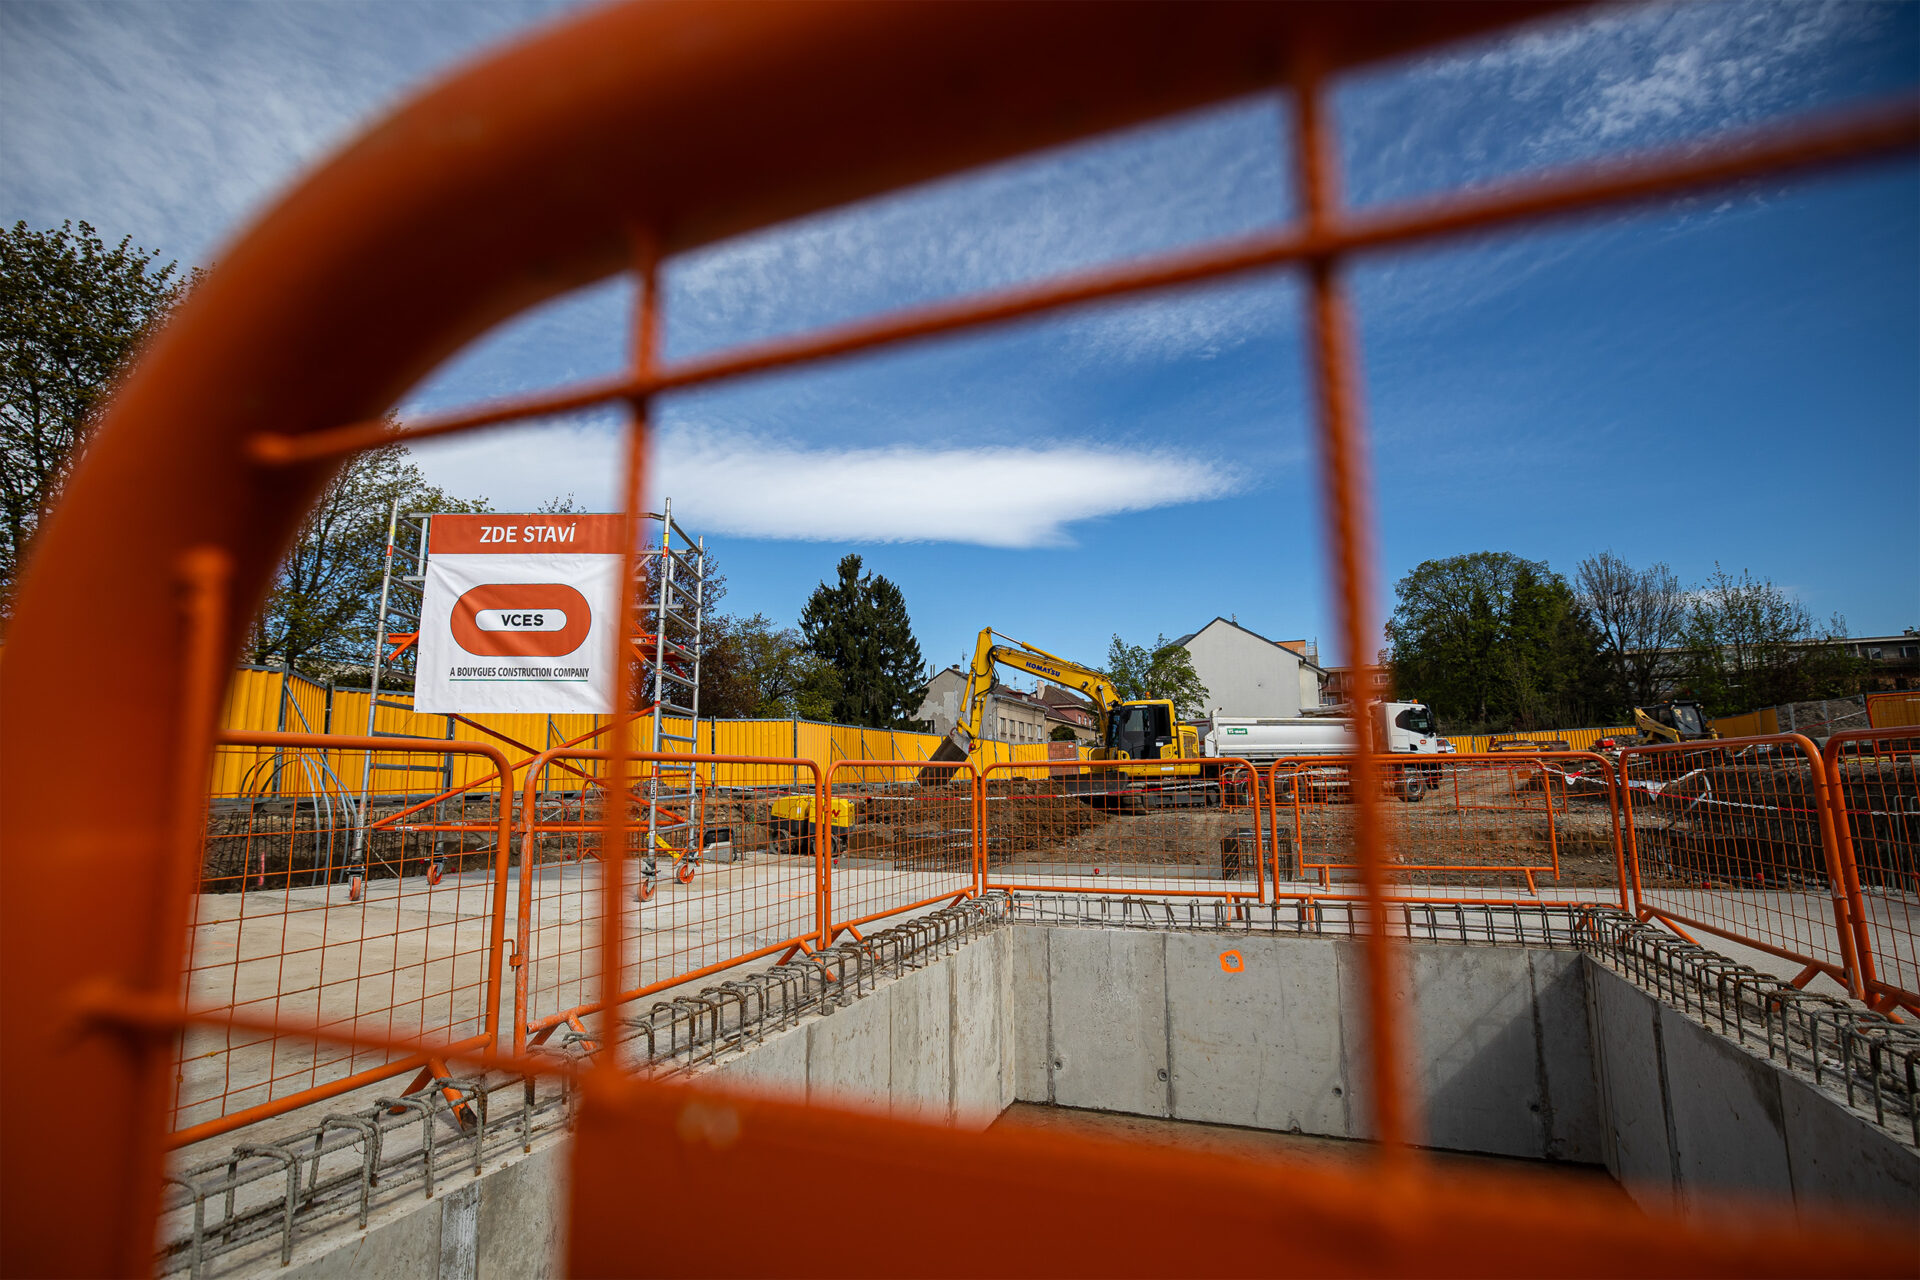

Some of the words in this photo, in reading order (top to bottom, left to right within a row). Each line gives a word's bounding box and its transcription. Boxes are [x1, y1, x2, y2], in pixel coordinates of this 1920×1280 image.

[480, 526, 517, 543] ZDE
[523, 522, 576, 543] STAVÍ
[501, 614, 544, 626] VCES
[450, 667, 455, 677] A
[457, 667, 496, 677] BOUYGUES
[497, 667, 552, 677] CONSTRUCTION
[553, 667, 589, 677] COMPANY
[1025, 661, 1060, 677] KOMATSU
